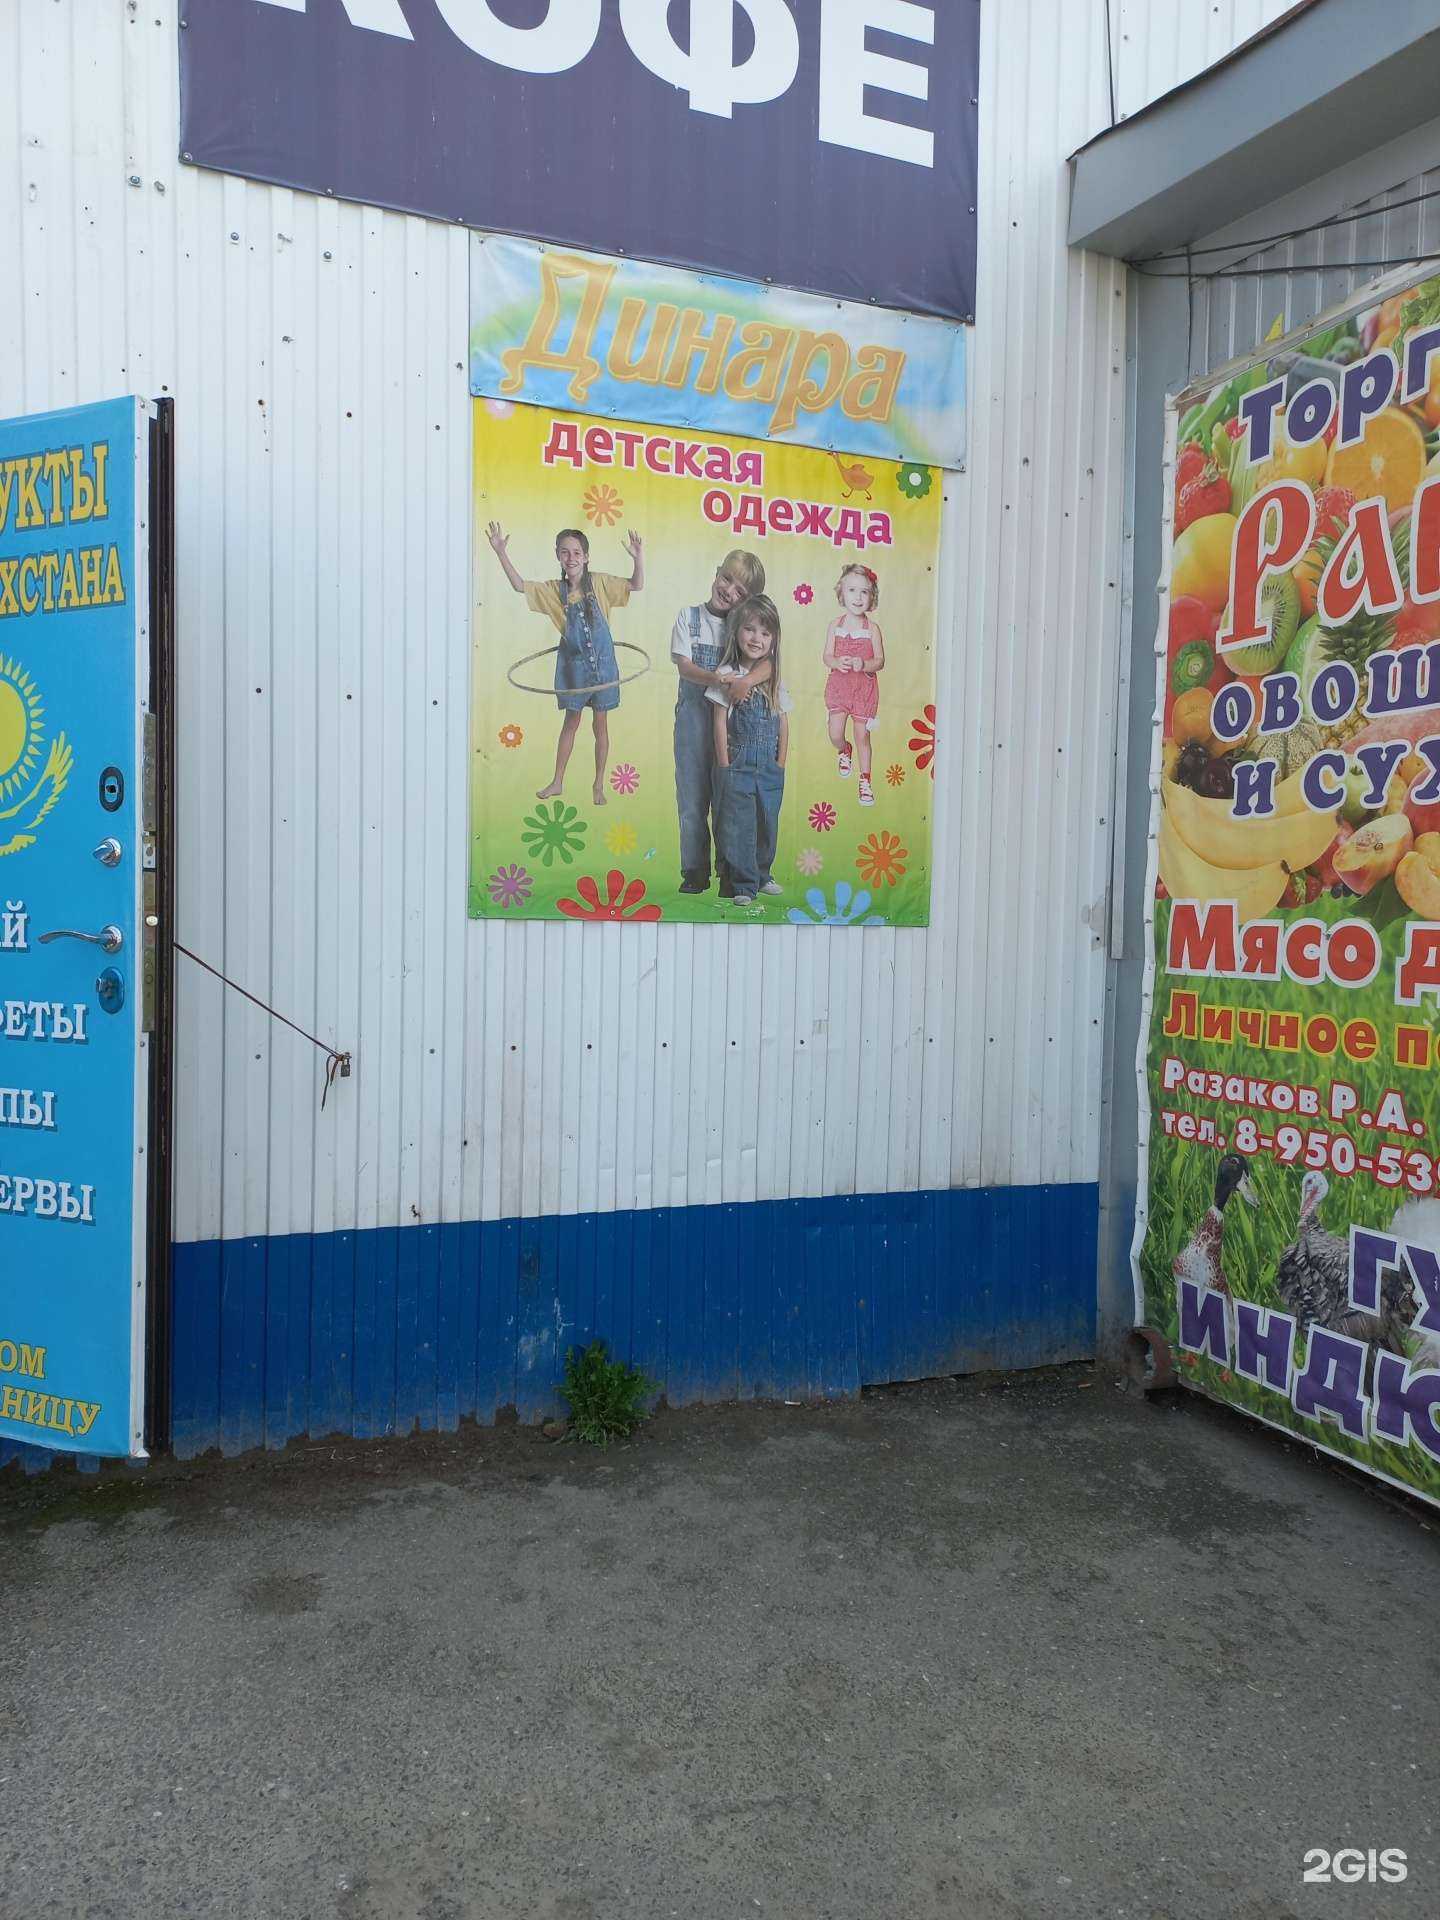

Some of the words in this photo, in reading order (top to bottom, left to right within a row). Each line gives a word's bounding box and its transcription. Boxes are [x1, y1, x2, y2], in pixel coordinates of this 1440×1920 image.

[250, 0, 935, 168] ФЕ
[501, 253, 907, 433] Динара
[543, 421, 764, 486] детская
[702, 489, 894, 549] одежда
[0, 546, 125, 616] ХСТАНА
[0, 899, 28, 949] Й
[1167, 901, 1378, 982] Мясо
[0, 1000, 87, 1041] ЕТЫ
[1163, 990, 1378, 1061] Личное
[1395, 1024, 1440, 1070] п
[1163, 1058, 1320, 1116] Разаков
[1329, 1080, 1426, 1138] Р.А.
[1162, 1108, 1226, 1149] тел.
[1234, 1118, 1440, 1196] 8-950-53
